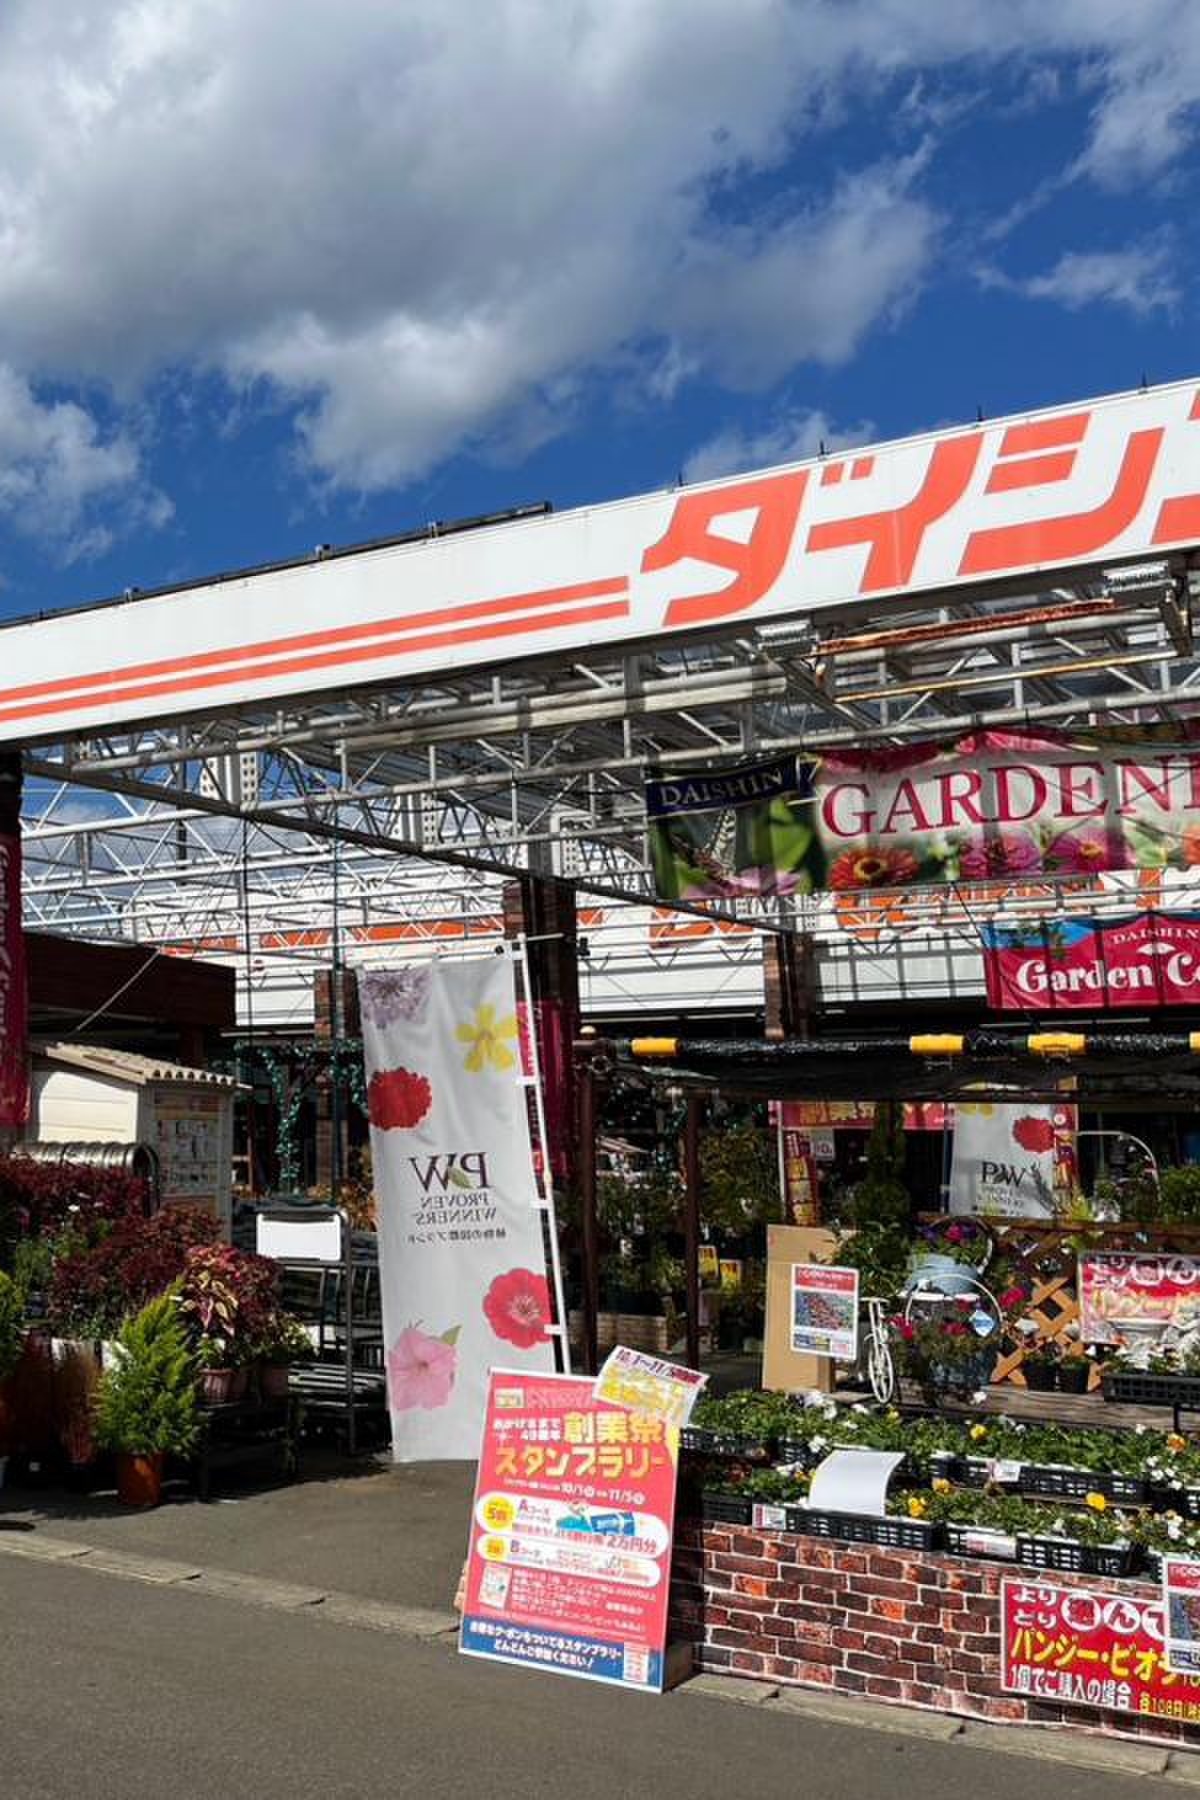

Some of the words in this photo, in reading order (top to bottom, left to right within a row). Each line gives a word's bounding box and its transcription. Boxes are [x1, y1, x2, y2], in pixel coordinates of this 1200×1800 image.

[640, 388, 1200, 626] ダイシ
[660, 768, 783, 806] DAISHIN
[1017, 959, 1154, 993] Garden
[982, 1161, 1026, 1187] PW
[495, 1445, 664, 1479] スタンプラリー
